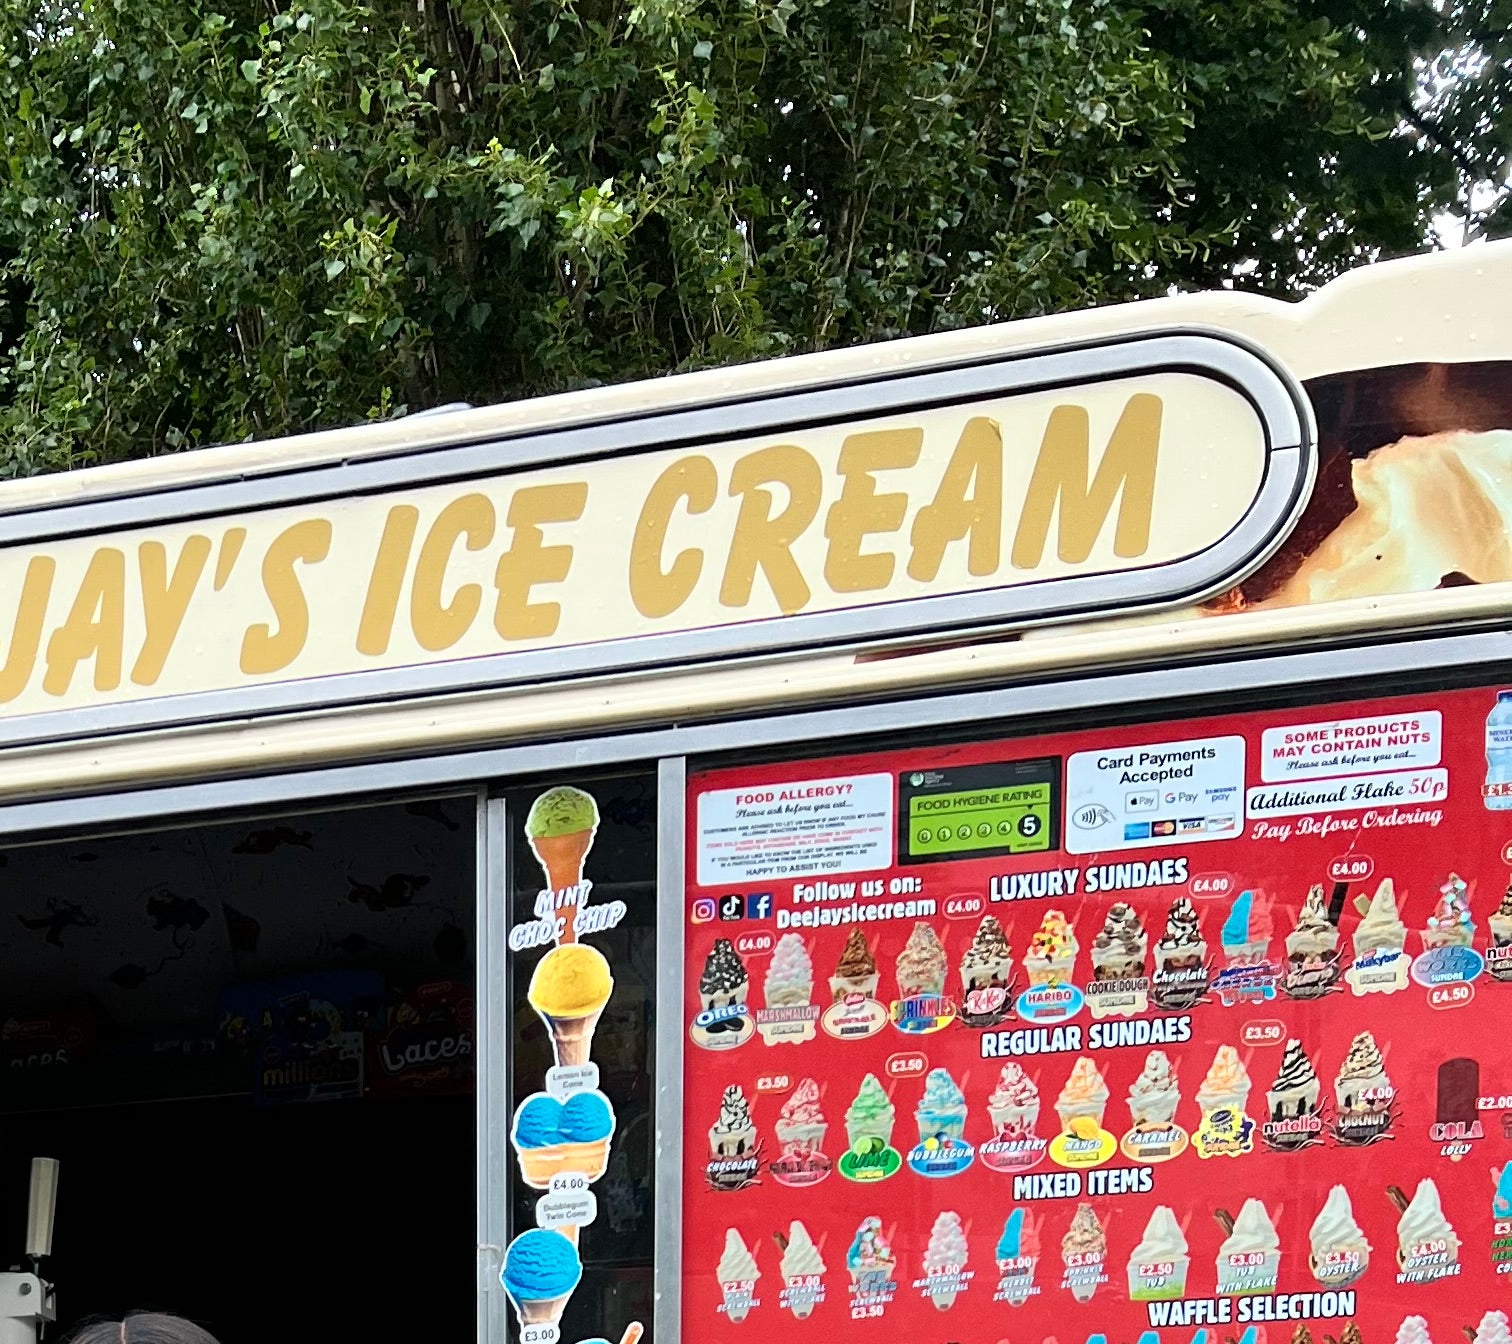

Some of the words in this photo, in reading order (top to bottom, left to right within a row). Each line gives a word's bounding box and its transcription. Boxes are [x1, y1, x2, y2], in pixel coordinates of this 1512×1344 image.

[354, 483, 588, 659] ICE
[628, 393, 1163, 618] CREAM
[1284, 730, 1329, 745] SOME
[1333, 720, 1420, 740] PRODUCTS
[1272, 744, 1297, 759] MAY
[1301, 736, 1382, 756] CONTAIN
[1388, 731, 1431, 747] NUTS
[1096, 754, 1135, 771] Card
[1138, 746, 1216, 767] Payments
[1286, 757, 1319, 771] Please
[1320, 755, 1338, 769] ask
[1340, 751, 1370, 768] before
[1371, 753, 1390, 765] you
[1119, 765, 1194, 785] Accepted
[736, 792, 774, 805] FOOD
[779, 784, 853, 801] ALLERGY?
[917, 797, 951, 812] FOOD
[954, 793, 1000, 809] HYGIENE
[1002, 788, 1043, 803] RATING
[1250, 781, 1346, 811] Additional
[1350, 778, 1405, 801] Flake
[1408, 777, 1446, 800] 50p
[736, 805, 765, 819] Please
[767, 804, 782, 816] ask
[784, 801, 812, 815] before
[814, 802, 830, 813] you
[1023, 817, 1036, 836] 5
[1251, 819, 1292, 843] Pay
[1296, 813, 1359, 836] Before
[1361, 805, 1443, 832] Ordering
[746, 867, 774, 876] HAPPY
[776, 865, 788, 874] TO
[789, 863, 819, 872] ASSIST
[1332, 860, 1368, 876] £4.00
[989, 870, 1083, 902] LUXURY
[1084, 858, 1188, 893] SUNDAES
[1193, 878, 1229, 893] £4.00
[535, 880, 593, 917] MINT
[793, 881, 856, 904] Follow
[861, 878, 884, 897] us
[890, 876, 922, 895] on:
[946, 899, 981, 914] £4.00
[509, 914, 566, 951] CHOC
[572, 900, 627, 936] CHIP
[738, 936, 772, 952] £4.00
[1153, 968, 1208, 984] Chocolate
[1088, 981, 1116, 995] COOKIE
[1119, 979, 1149, 993] DOUGH
[1432, 986, 1469, 1003] £4.50
[1027, 991, 1073, 1003] HARIBO
[697, 1004, 749, 1026] OREO
[756, 1006, 821, 1023] MARSHMALLOW
[981, 1026, 1082, 1058] REGULAR
[1089, 1016, 1191, 1049] SUNDAES
[1245, 1025, 1281, 1040] £3.50
[382, 1029, 473, 1073] Laces
[890, 1058, 924, 1073] £3.50
[757, 1076, 789, 1090] £3.50
[1357, 1086, 1394, 1101] £4.00
[1262, 1116, 1322, 1135] nutella
[1429, 1122, 1485, 1142] COLA
[979, 1139, 1048, 1154] RASPBERRY
[1063, 1140, 1103, 1152] MANGO
[1128, 1131, 1182, 1145] CARAMEL
[907, 1146, 975, 1162] BUBBLEGUM
[1440, 1143, 1473, 1156] LOLLY
[707, 1158, 758, 1172] CHOCOLATE
[848, 1152, 891, 1169] LIME
[553, 1178, 585, 1192] £4.00
[1013, 1176, 1082, 1201] MIXED
[1088, 1168, 1153, 1194] ITEMS
[1229, 1253, 1264, 1266] £3.00
[1325, 1252, 1359, 1264] £3.50
[1407, 1254, 1448, 1269] OYSTER
[1139, 1264, 1173, 1276] £2.50
[1320, 1263, 1359, 1277] OYSTER
[1145, 1276, 1165, 1288] TUB
[1216, 1281, 1240, 1295] WITH
[1241, 1276, 1278, 1291] FLAKE
[1148, 1299, 1232, 1327] WAFFLE
[1238, 1292, 1355, 1322] SELECTION
[524, 1328, 556, 1342] £3.00
